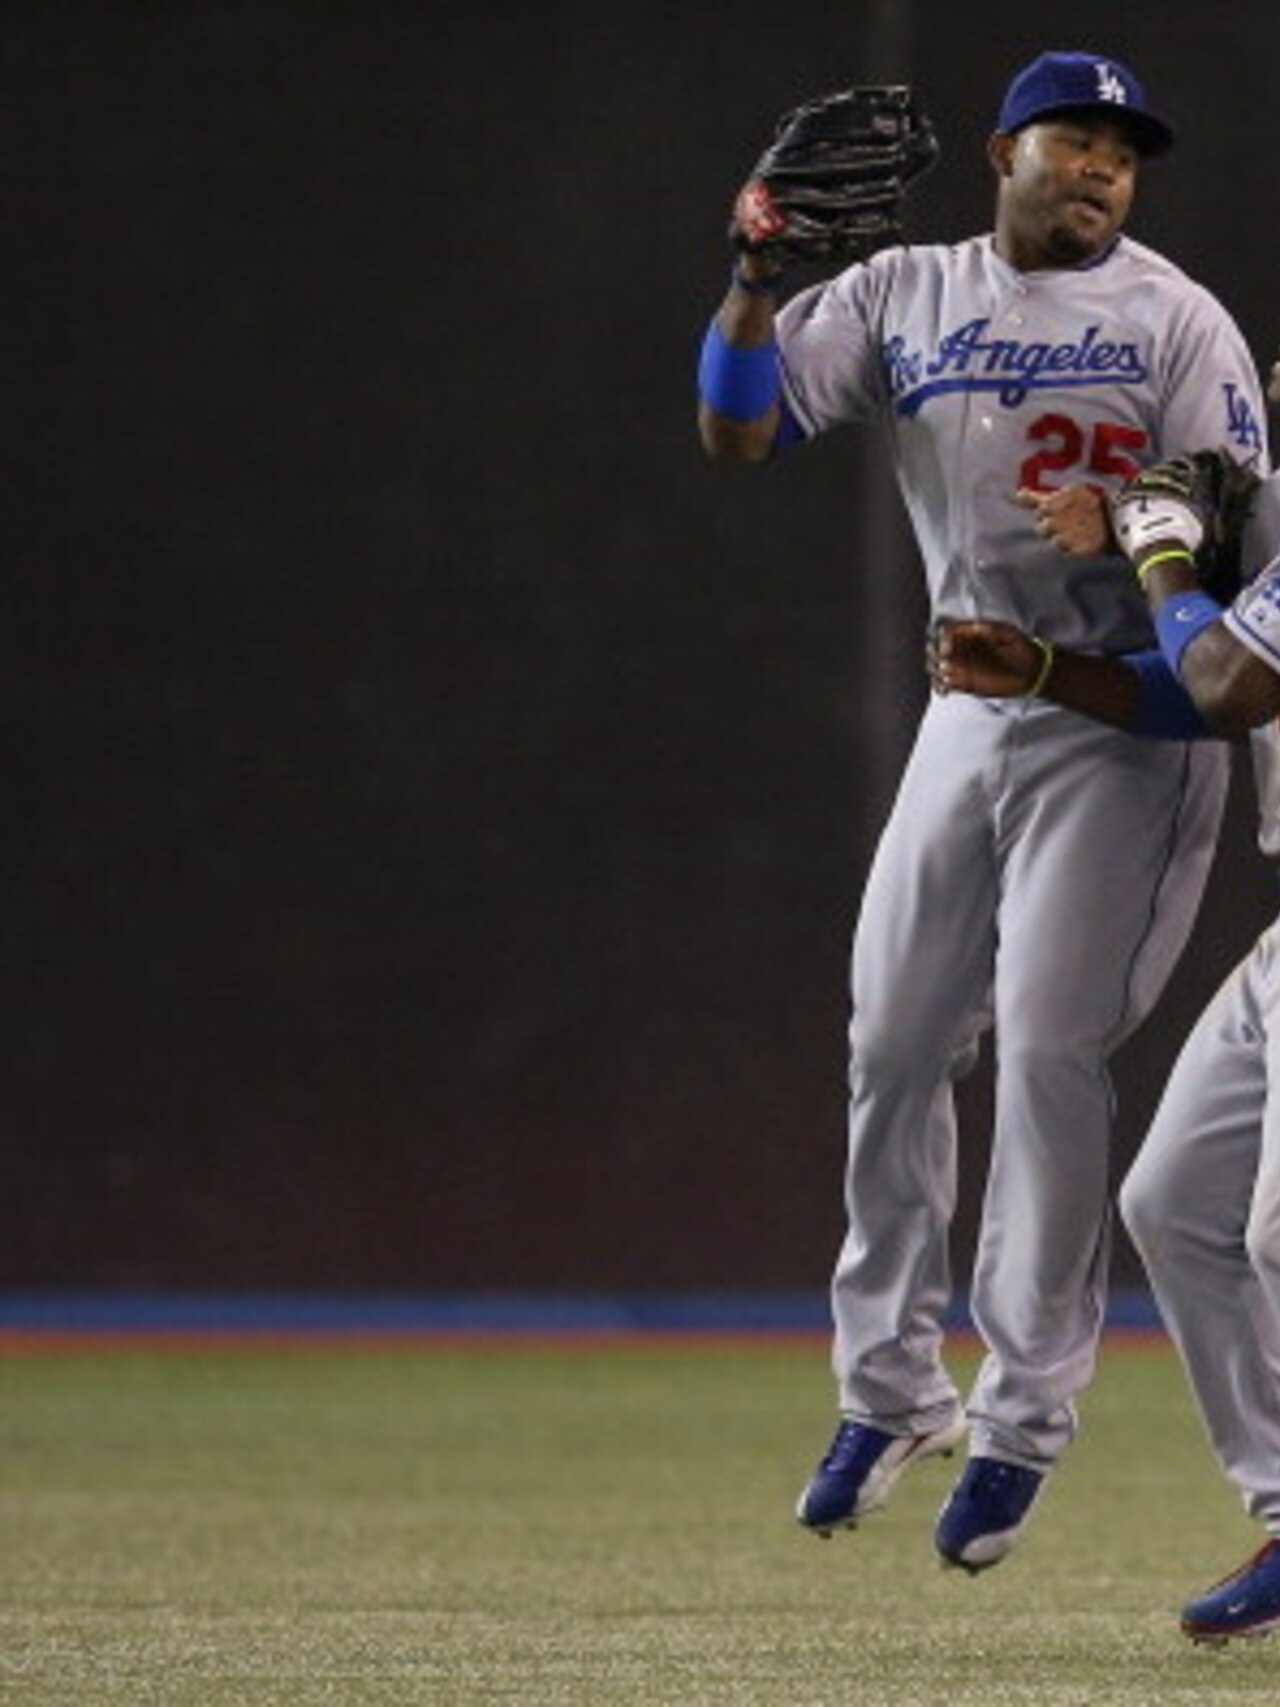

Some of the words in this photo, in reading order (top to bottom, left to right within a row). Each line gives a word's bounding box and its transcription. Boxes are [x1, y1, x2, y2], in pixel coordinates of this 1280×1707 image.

[1094, 63, 1126, 104] LA
[926, 319, 1148, 408] Angeles
[1222, 383, 1262, 450] LA
[1017, 413, 1148, 495] 25
